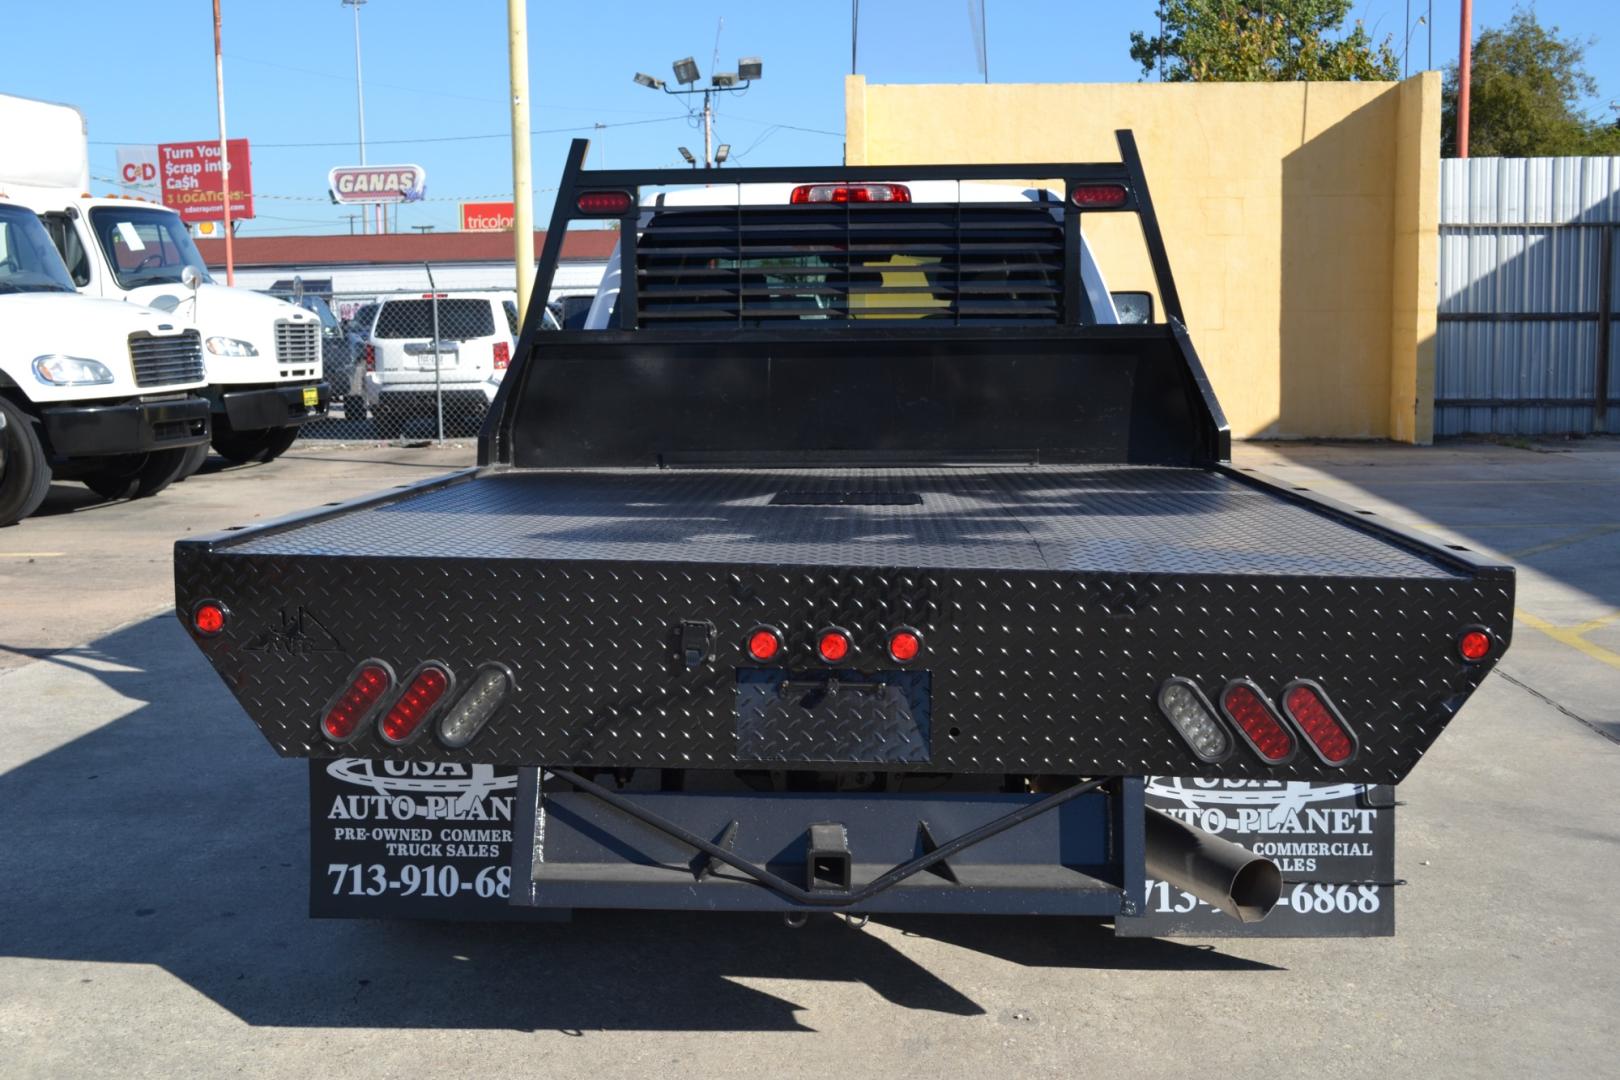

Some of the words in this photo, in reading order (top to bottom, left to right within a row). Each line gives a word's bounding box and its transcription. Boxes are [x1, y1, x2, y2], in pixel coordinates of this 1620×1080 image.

[163, 147, 194, 160] Turn
[196, 146, 223, 158] You
[165, 160, 202, 176] $crap
[166, 175, 199, 191] Ca$h
[339, 172, 414, 193] GANAS
[167, 193, 174, 204] 3
[468, 213, 515, 229] tricolor
[334, 827, 433, 841] PRE-OWNED
[440, 828, 513, 842] COMMER
[386, 843, 442, 857] TRUCK
[446, 844, 500, 858] SALES
[1253, 842, 1373, 856] COMMERCIAL
[1276, 858, 1317, 872] ALES
[327, 863, 511, 898] 713-910-68
